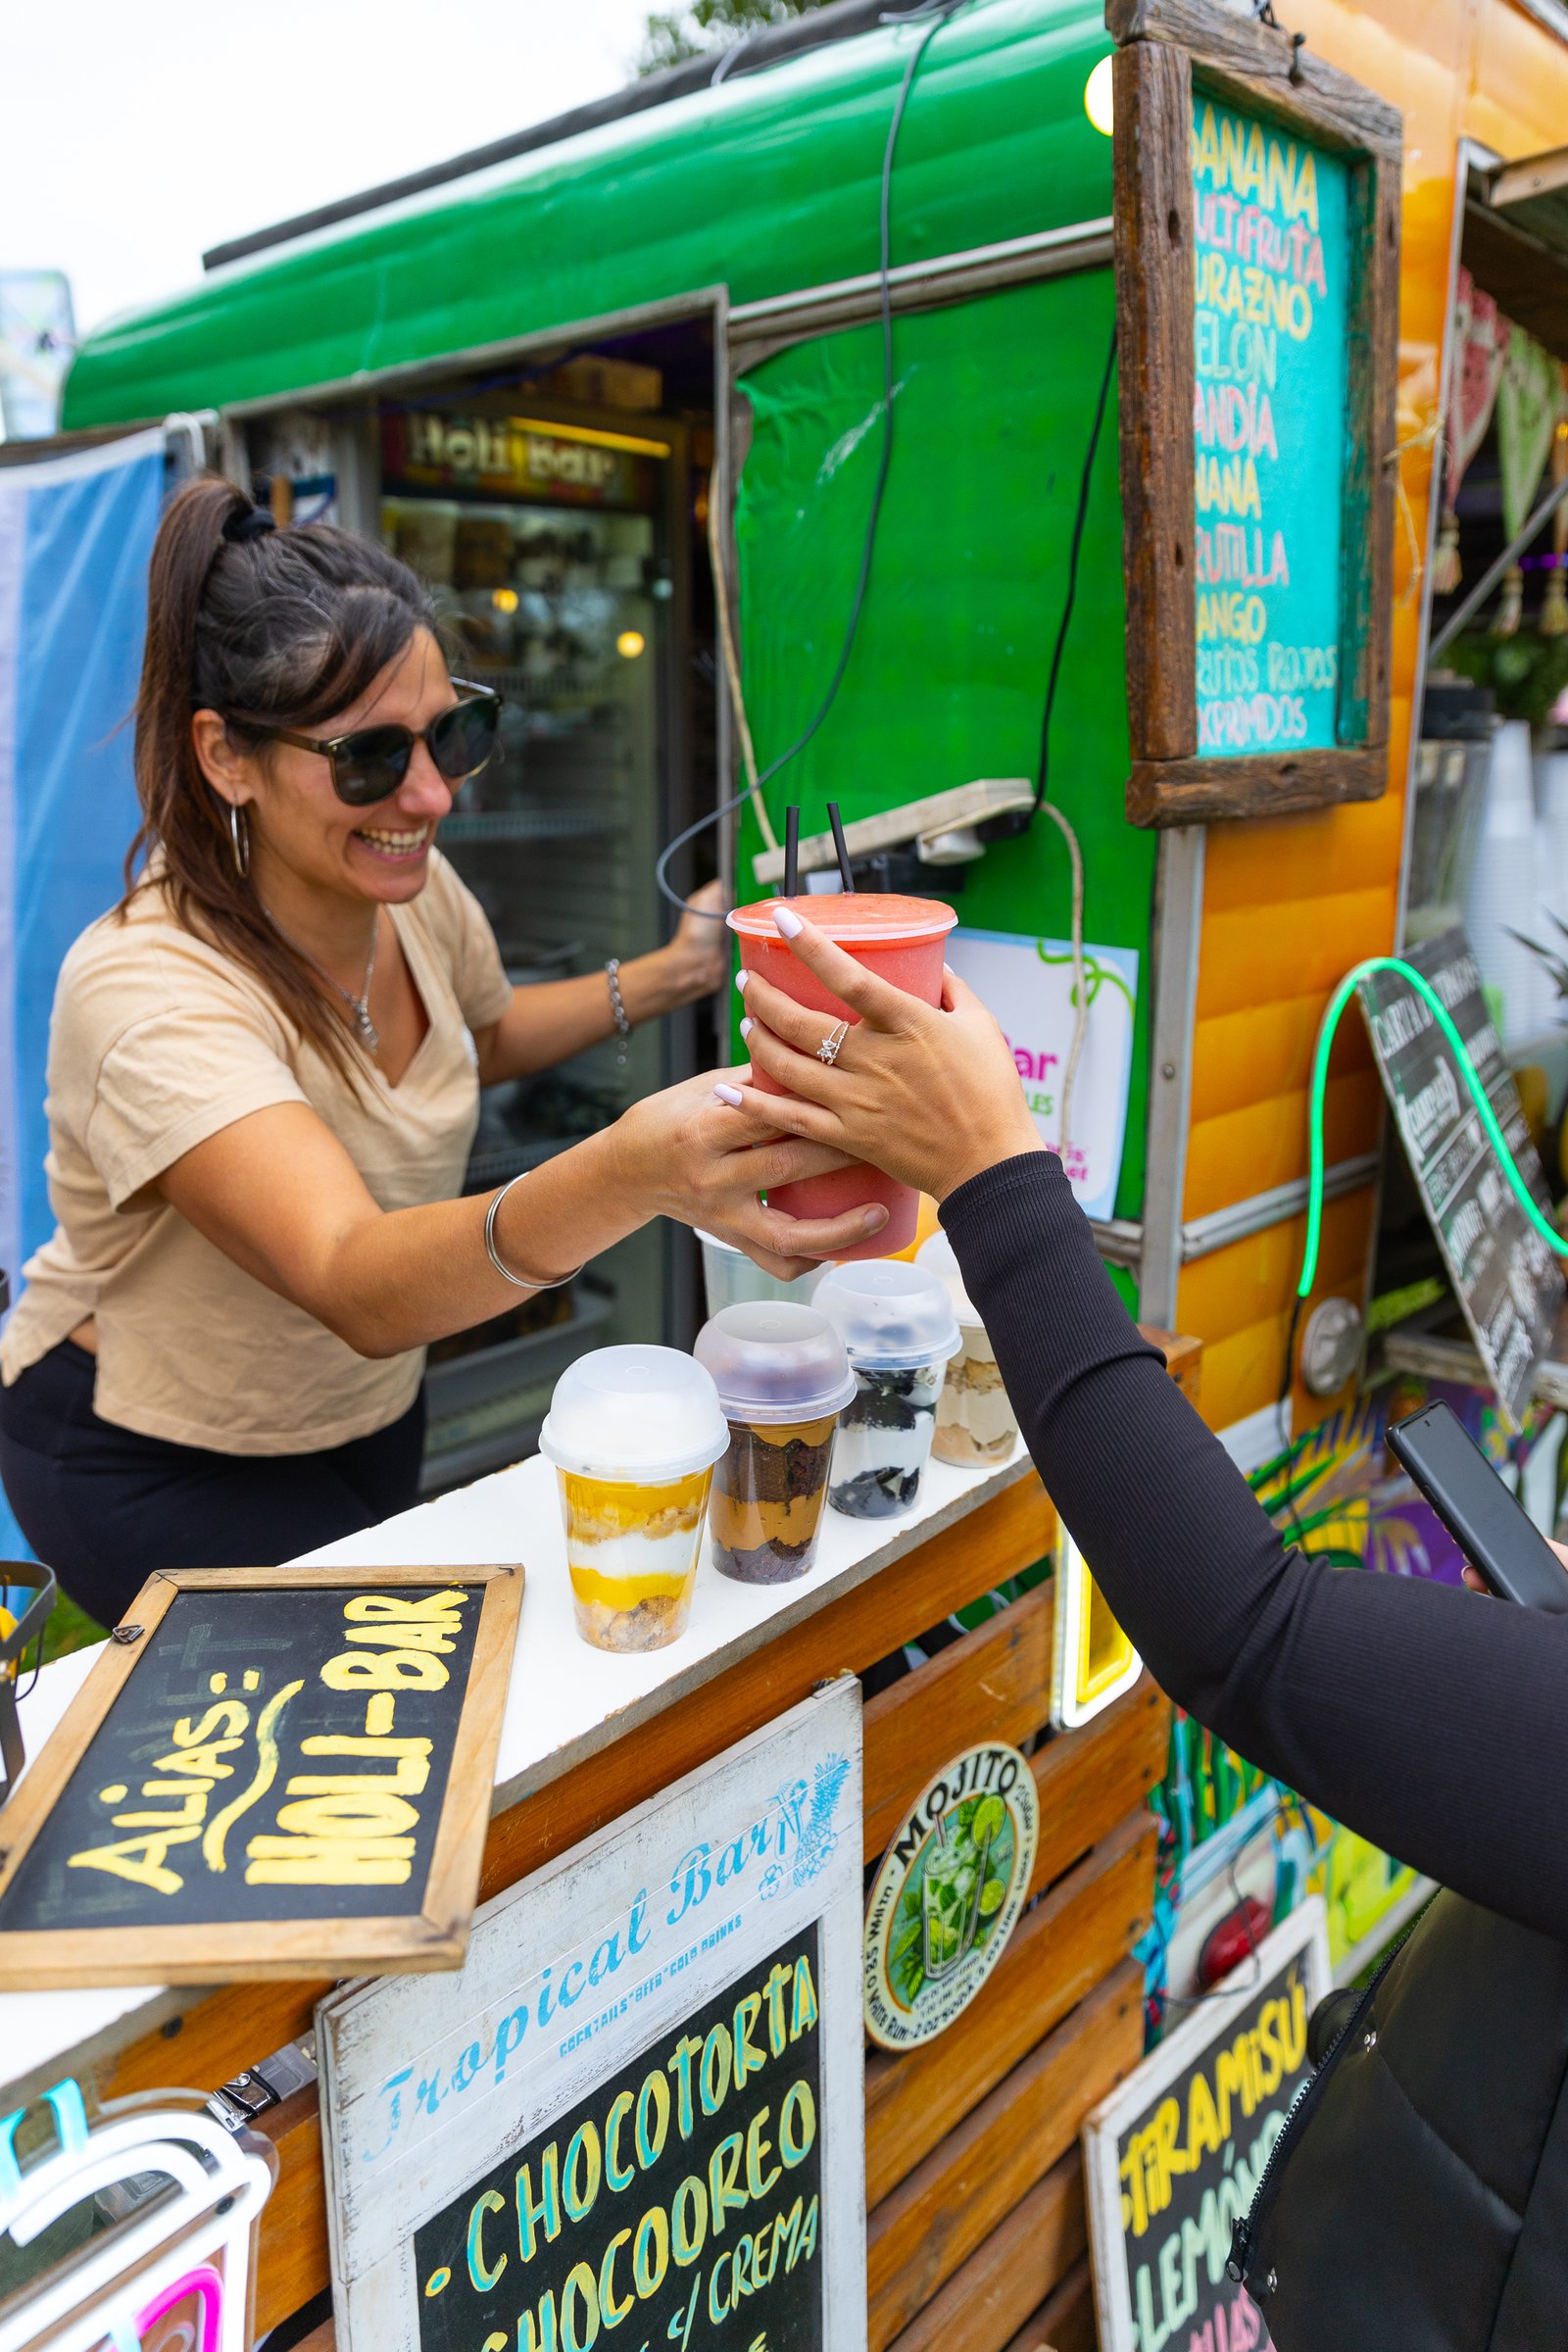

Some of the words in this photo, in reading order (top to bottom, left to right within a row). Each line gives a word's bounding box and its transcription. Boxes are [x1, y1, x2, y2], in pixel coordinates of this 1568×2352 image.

[1193, 191, 1327, 297] ULTIFRUTA
[1194, 251, 1313, 341] URAZNO
[1195, 310, 1276, 390] ELON
[1194, 453, 1262, 520] NANA
[1195, 522, 1290, 588] RUTILLA
[1195, 591, 1266, 646] ANGO
[245, 1590, 470, 1886] HOLI-BAR
[894, 1750, 1019, 1870] MOJITO
[363, 1886, 652, 2162] Tropical
[666, 1821, 774, 1926] Bar
[466, 1954, 819, 2292] CHOCOTORTA
[481, 2080, 817, 2352] HOCOOREO
[708, 2194, 819, 2326] CREMA
